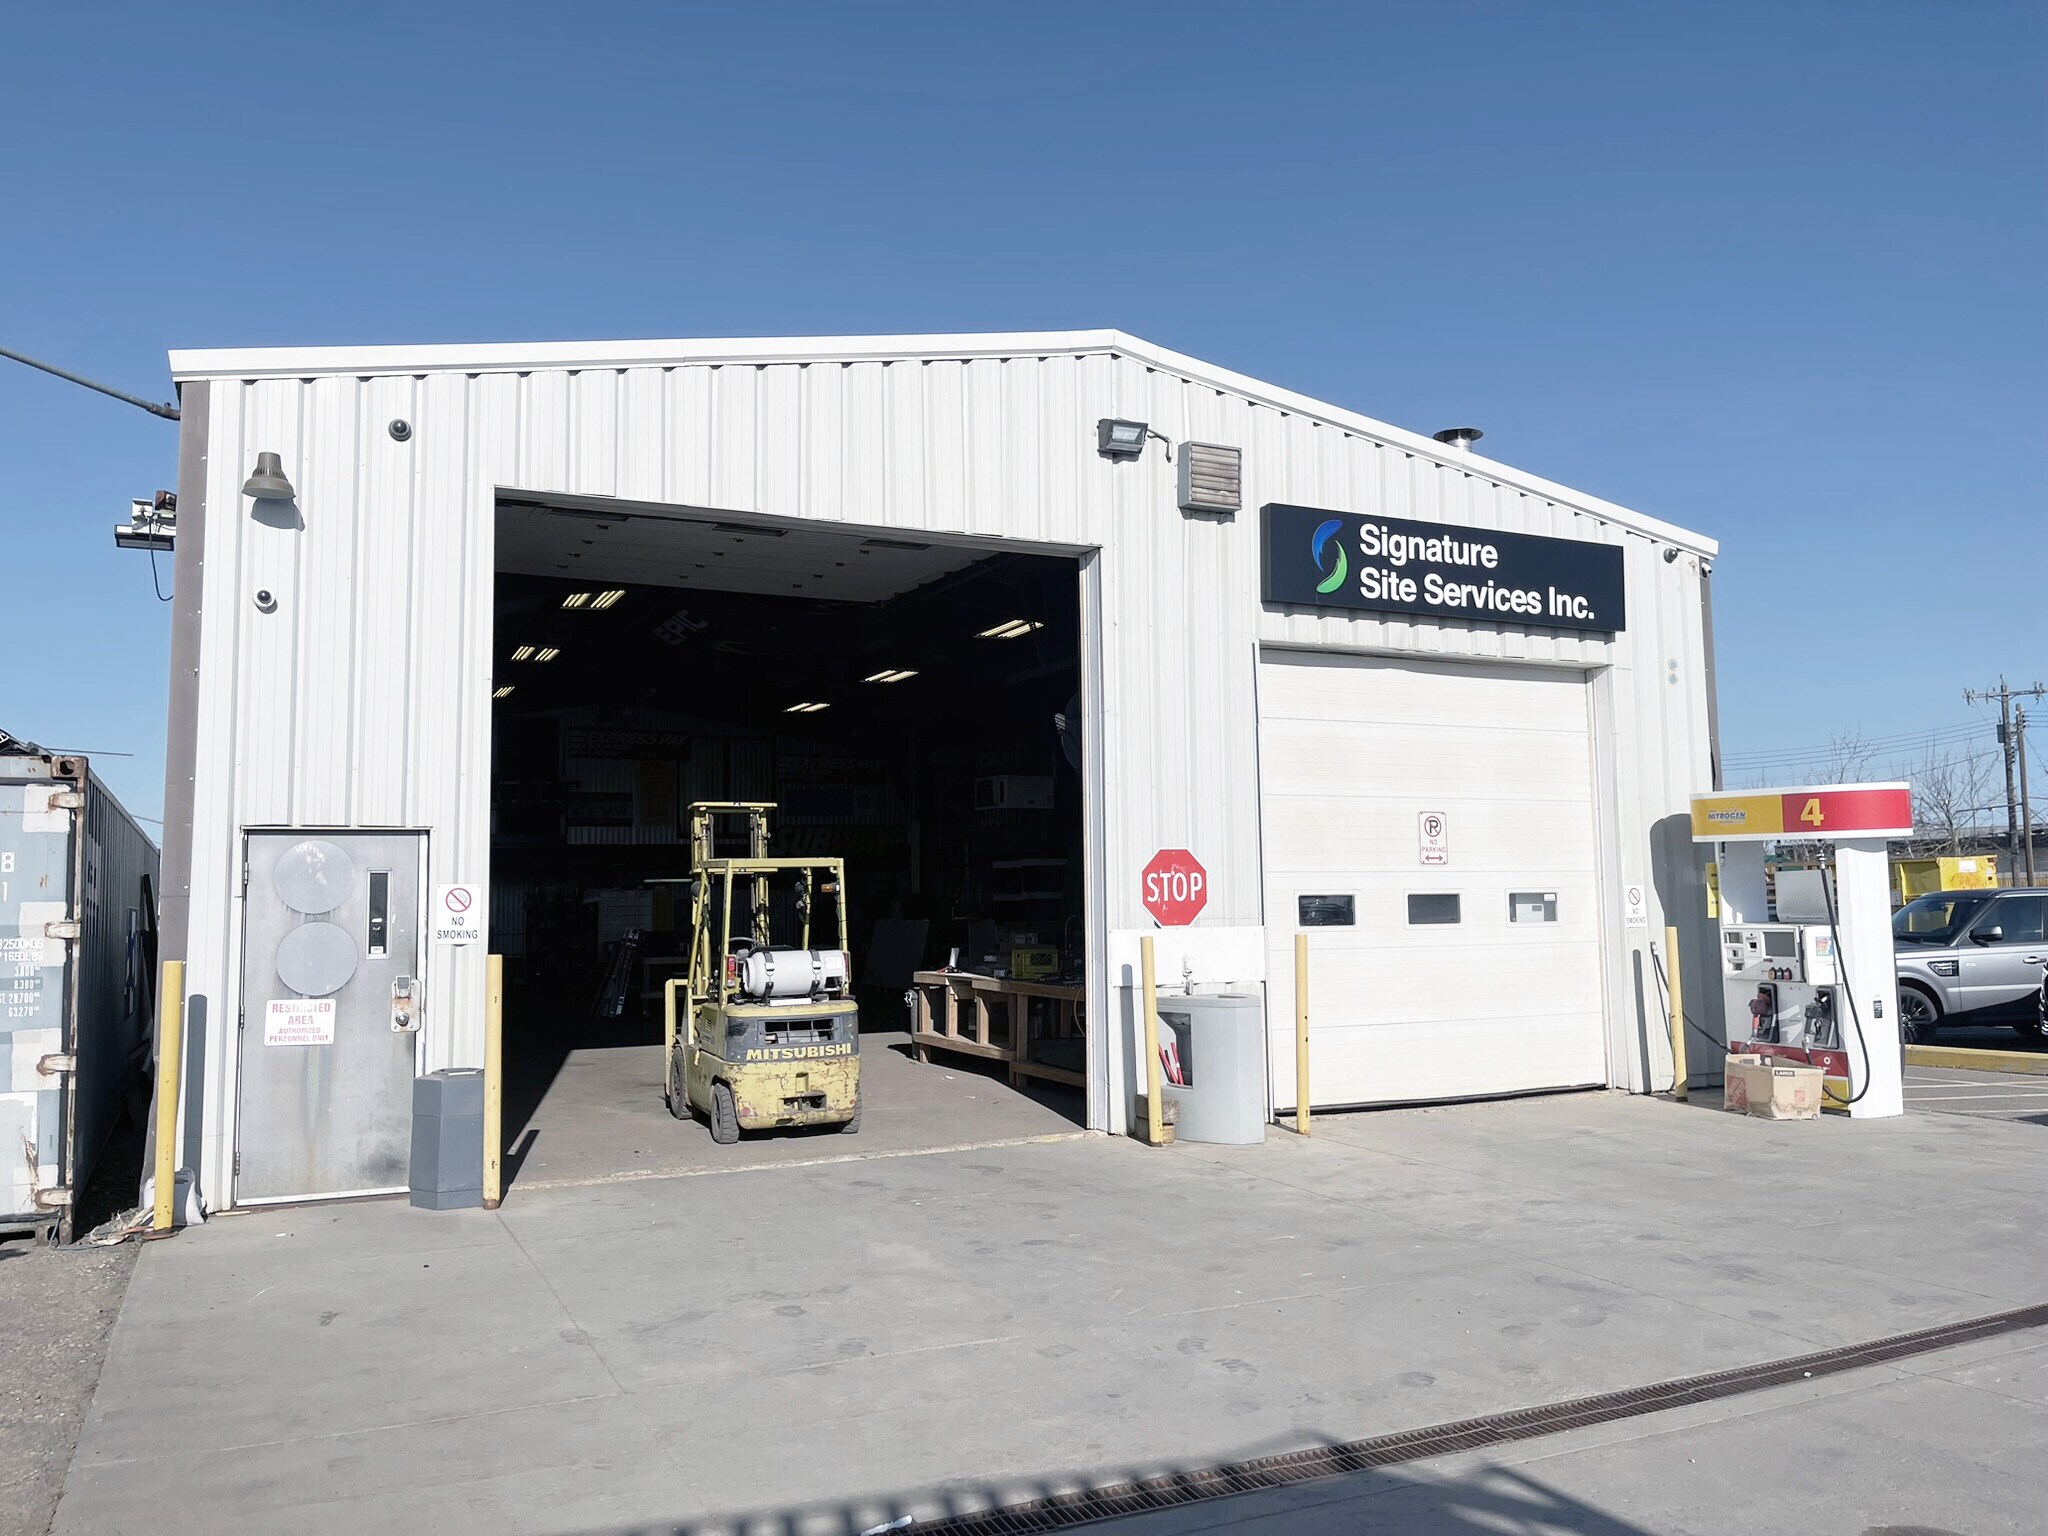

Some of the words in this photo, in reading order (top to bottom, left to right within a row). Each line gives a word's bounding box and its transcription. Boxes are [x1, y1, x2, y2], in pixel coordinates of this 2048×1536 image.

[1359, 523, 1498, 568] Signature
[1359, 566, 1418, 602] Site
[1424, 573, 1542, 615] Services
[1549, 586, 1595, 619] Inc.
[1708, 811, 1746, 820] NITROGEN
[1800, 798, 1825, 827] 4
[1146, 872, 1203, 902] STOP
[452, 916, 465, 926] NO
[436, 929, 478, 940] SMOKING
[287, 1015, 314, 1025] AREA
[746, 1043, 852, 1060] MITSUBISHI
